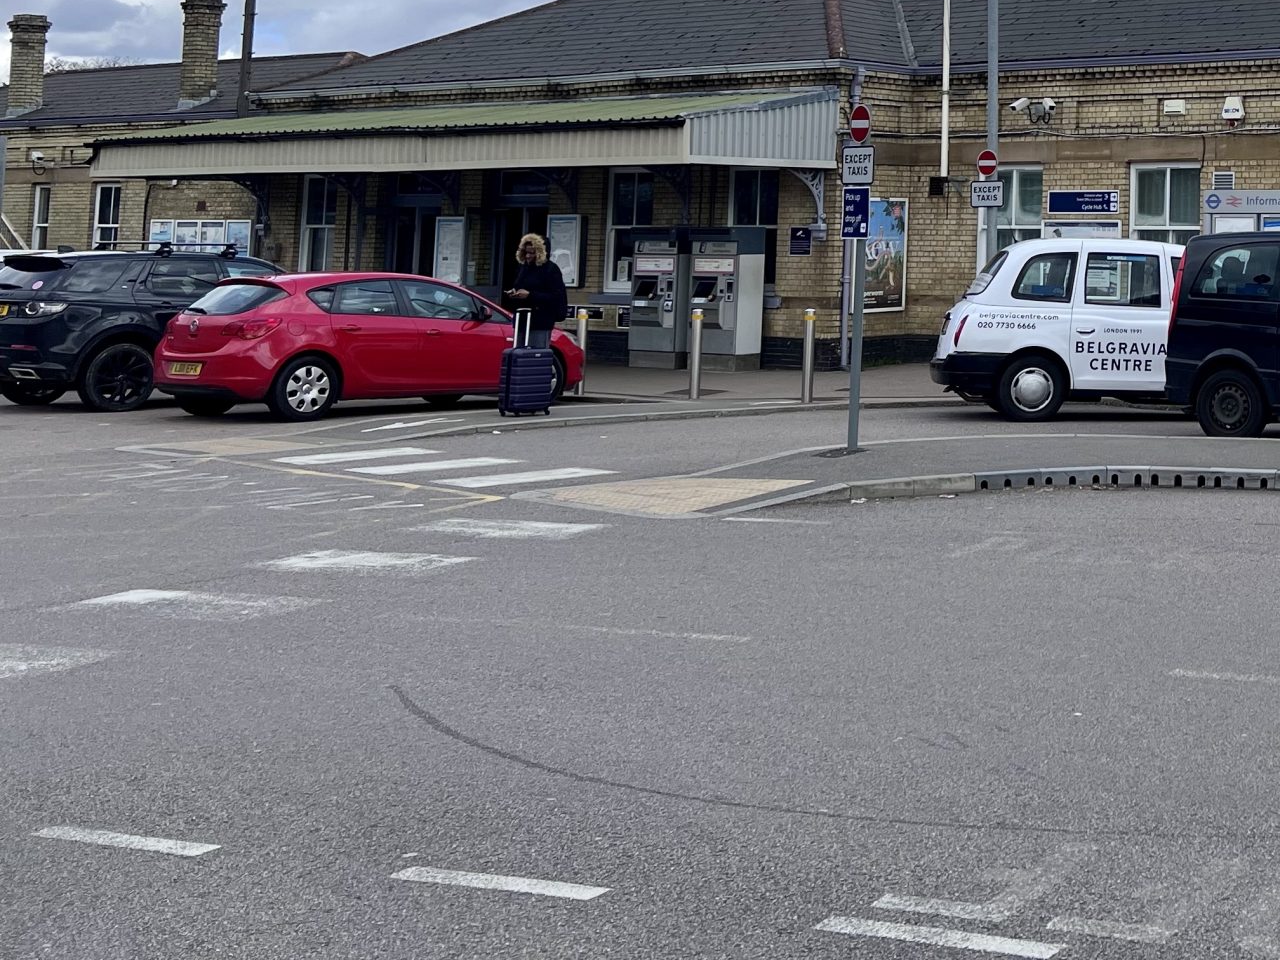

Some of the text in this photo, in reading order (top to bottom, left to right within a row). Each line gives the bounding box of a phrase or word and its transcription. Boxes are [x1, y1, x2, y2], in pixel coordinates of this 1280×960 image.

[844, 154, 872, 164] EXCEPT
[847, 166, 868, 176] TAXIS
[973, 186, 1001, 194] EXCEPT
[1075, 341, 1167, 355] BELGRAVIA
[1089, 358, 1152, 372] CENTRE
